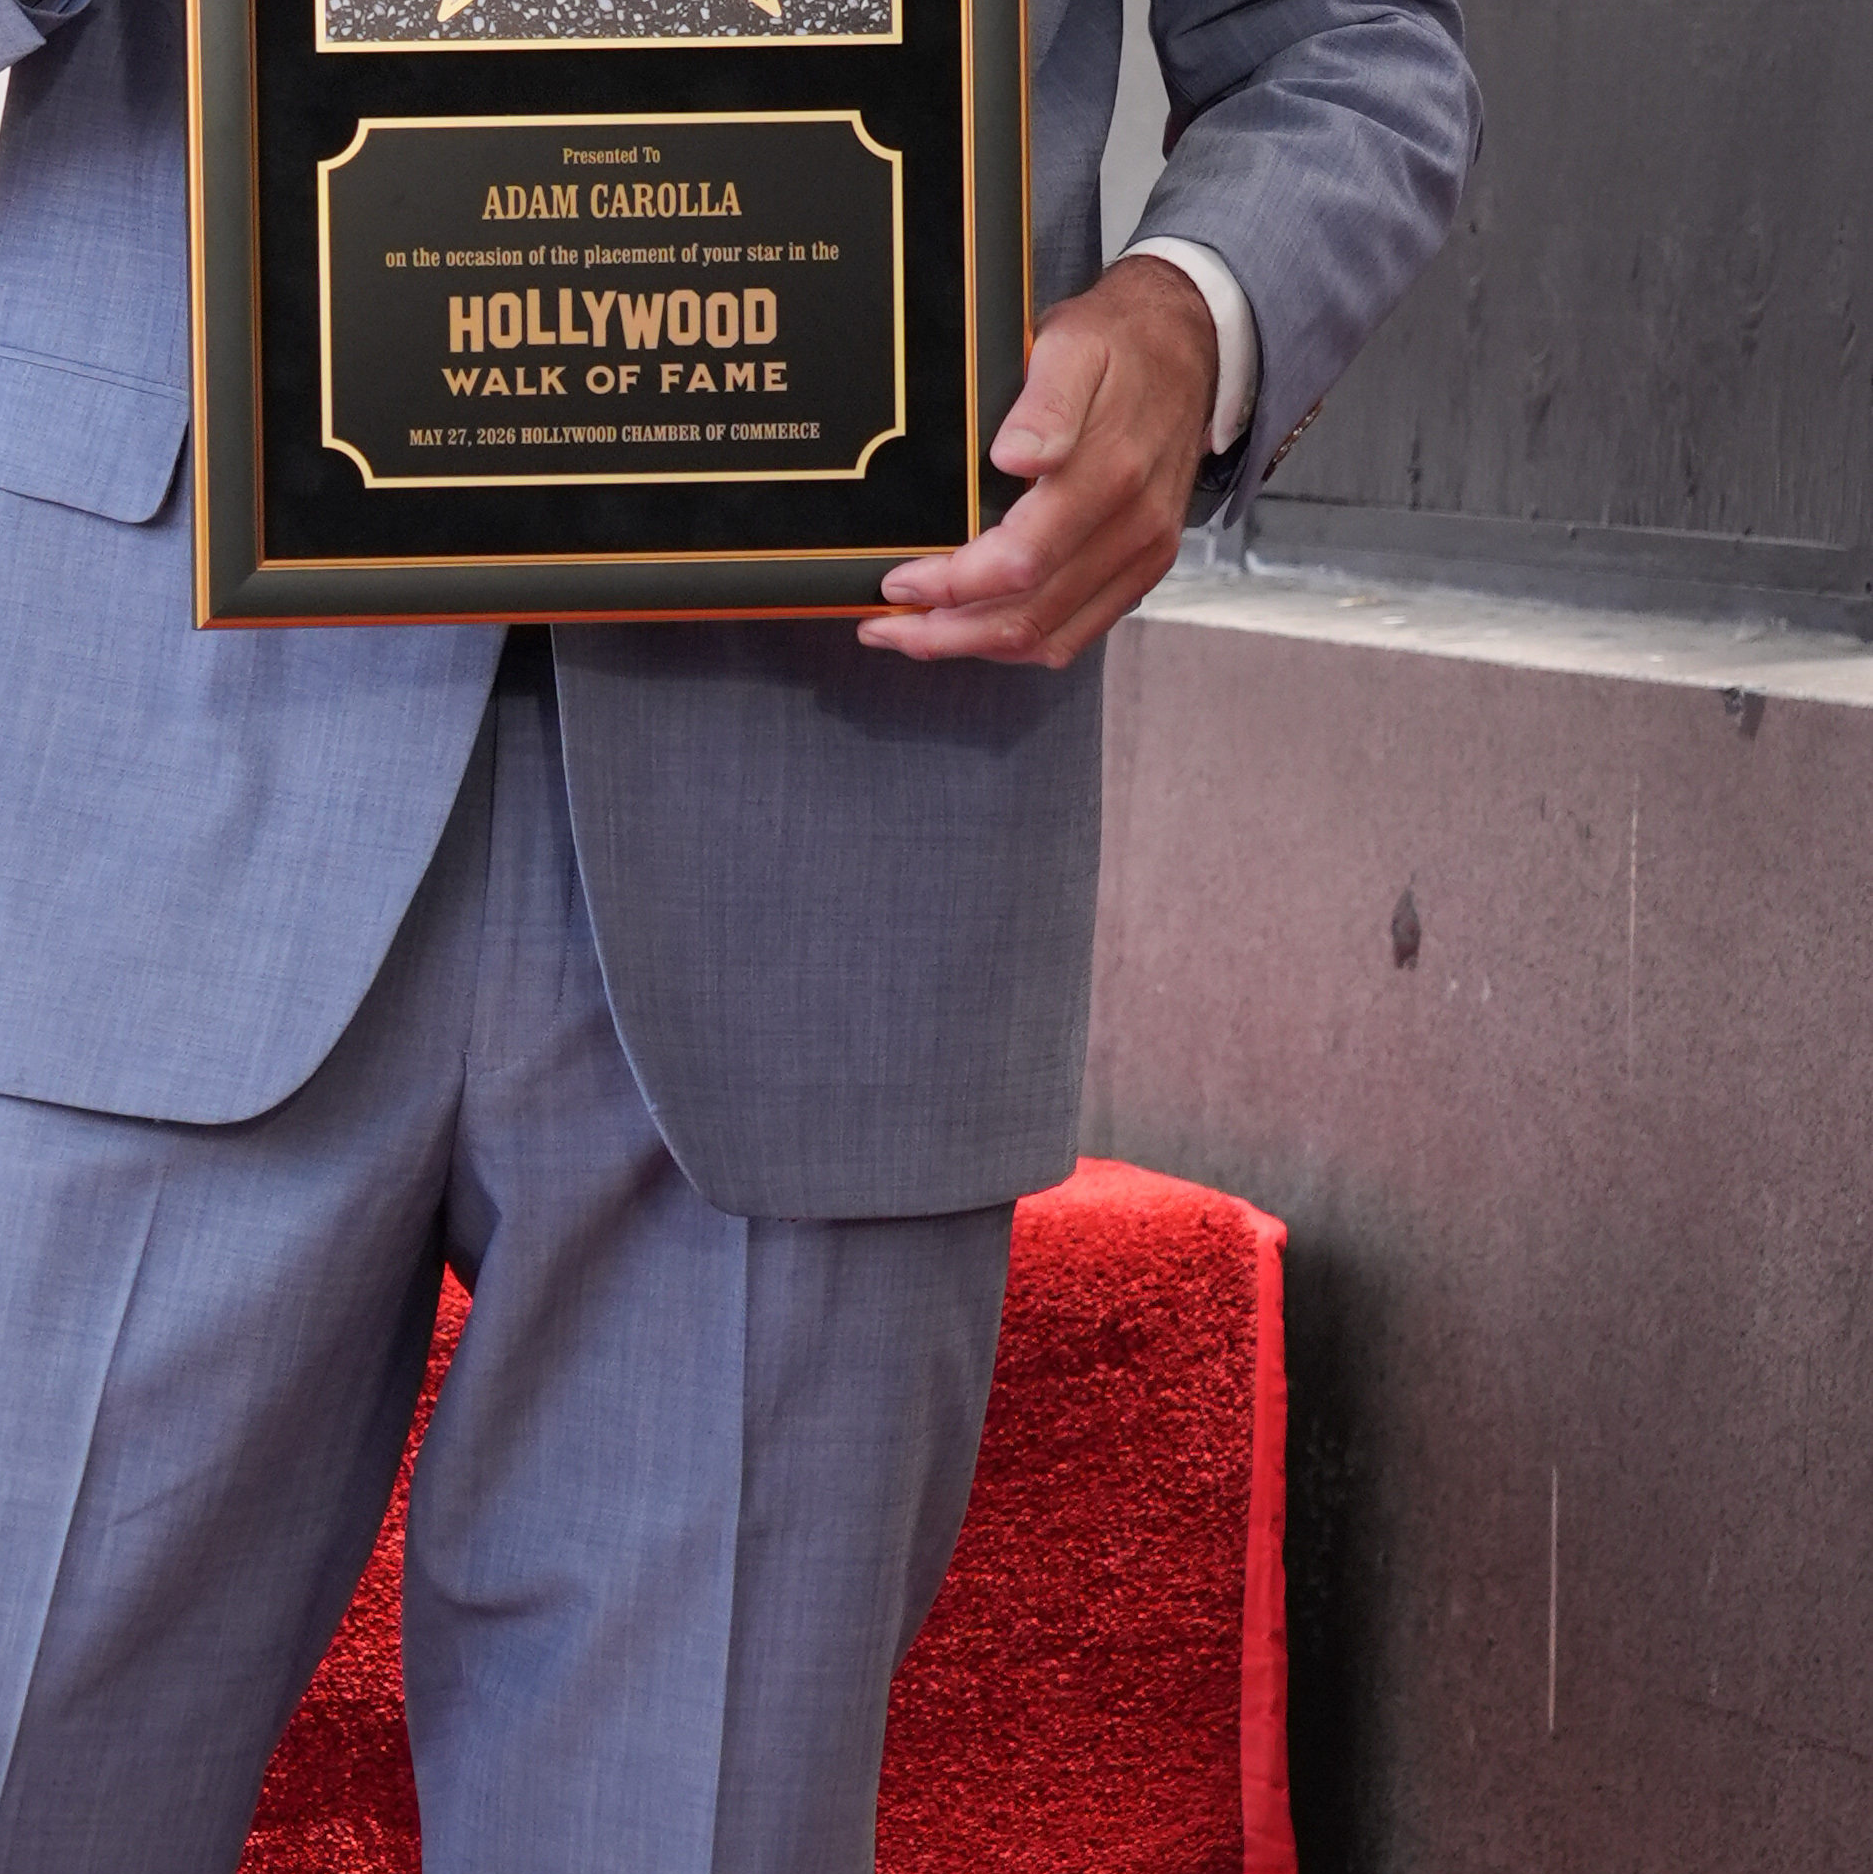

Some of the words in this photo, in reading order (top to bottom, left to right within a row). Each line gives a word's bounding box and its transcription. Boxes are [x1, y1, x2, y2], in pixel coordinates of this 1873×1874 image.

[563, 147, 637, 164] Presented
[643, 147, 660, 163] To
[482, 185, 579, 219] ADAM
[591, 183, 742, 218] CAROLLA
[386, 253, 406, 267] on
[413, 248, 440, 267] the
[446, 247, 523, 266] occasion
[529, 246, 546, 265] of
[551, 246, 578, 264] the
[585, 245, 675, 268] placement
[682, 243, 698, 262] of
[703, 247, 742, 266] your
[747, 244, 783, 261] star
[789, 242, 806, 260] in
[812, 241, 838, 260] the
[450, 288, 776, 352] HOLLYWOOD
[442, 367, 567, 396] WALK
[586, 366, 640, 394] OF
[660, 362, 787, 393] FAME
[410, 429, 443, 445] MAY
[448, 429, 472, 446] 27,
[477, 428, 515, 444] 2026
[522, 426, 616, 443] HOLLYWOOD
[622, 425, 701, 442] CHAMBER
[706, 424, 726, 441] OF
[731, 423, 819, 440] COMMERCE
